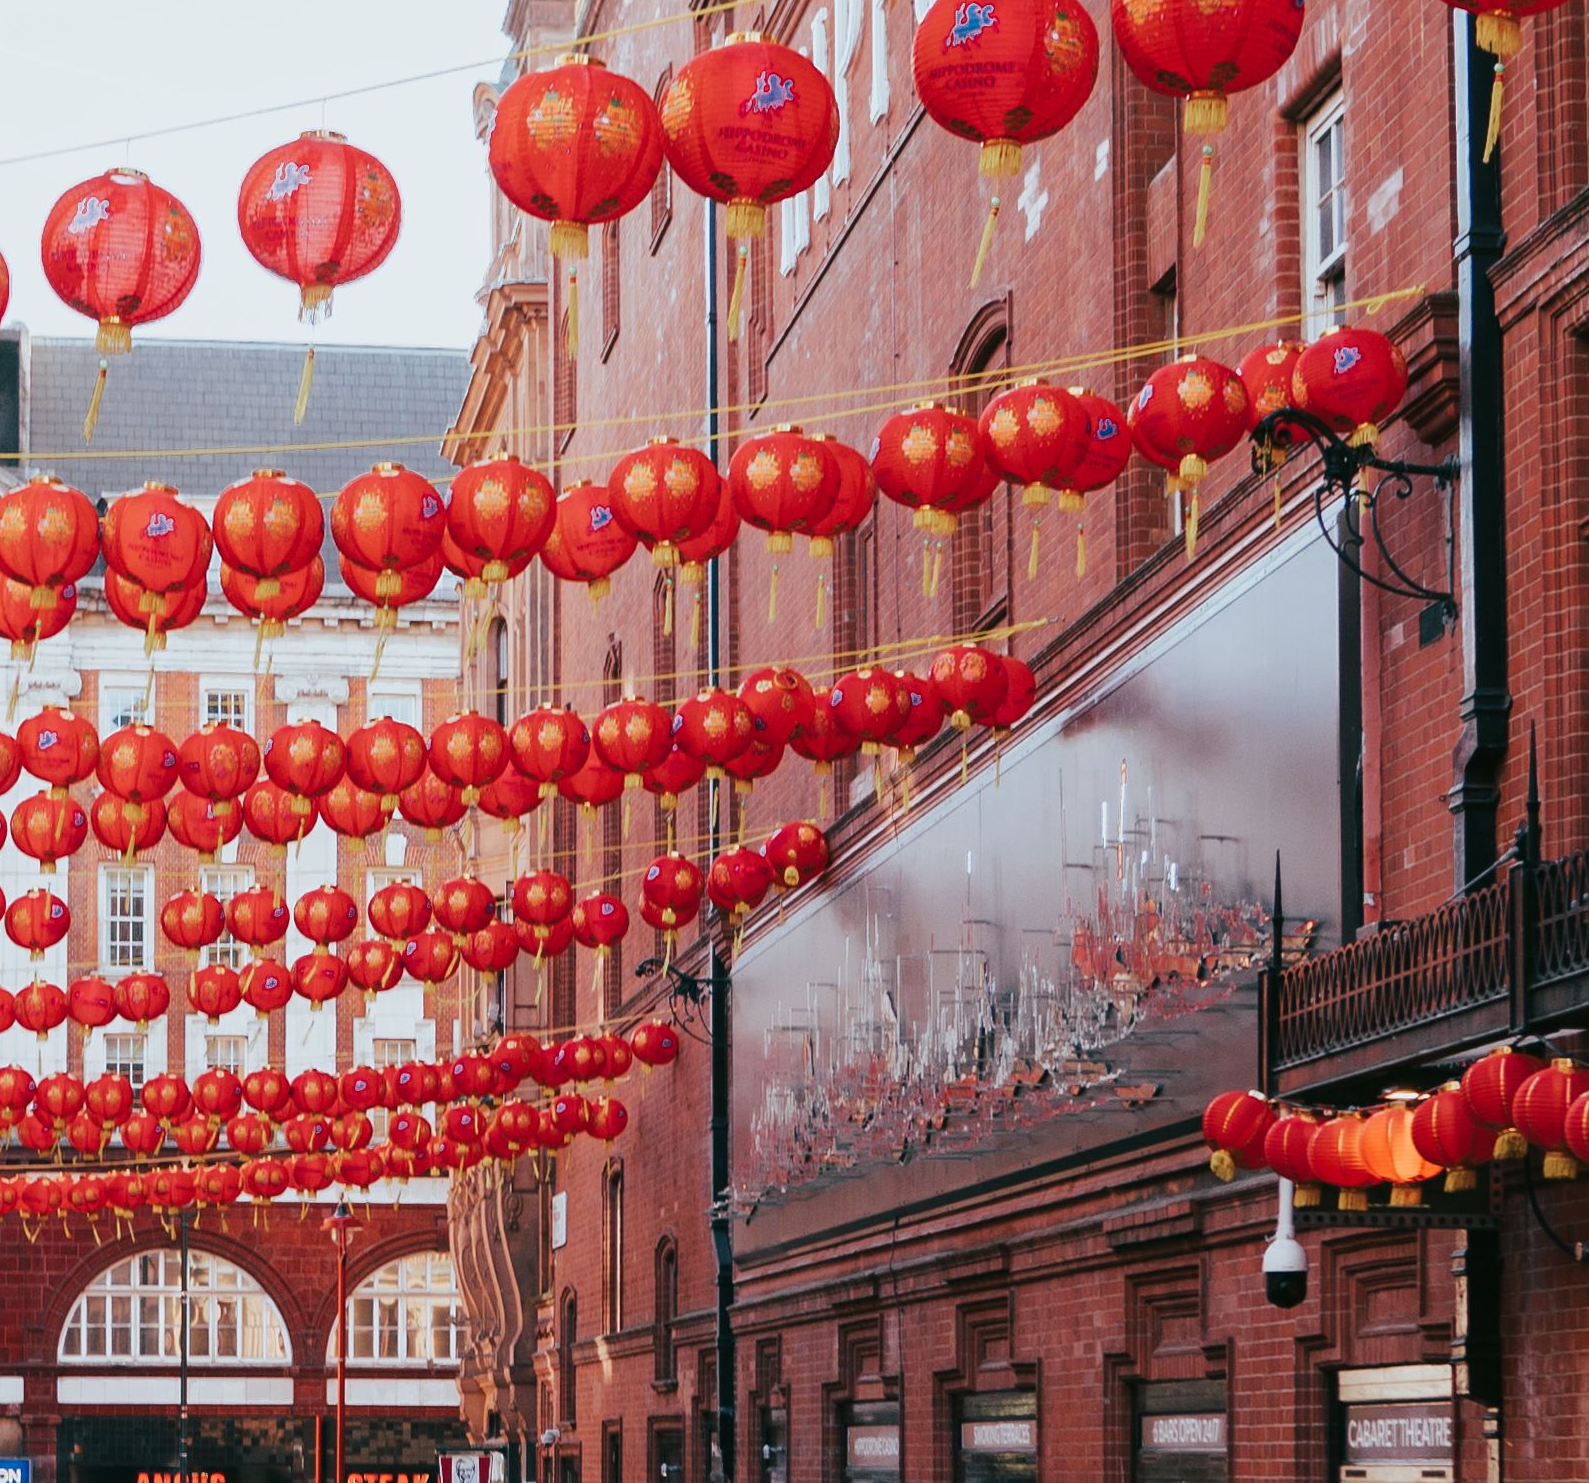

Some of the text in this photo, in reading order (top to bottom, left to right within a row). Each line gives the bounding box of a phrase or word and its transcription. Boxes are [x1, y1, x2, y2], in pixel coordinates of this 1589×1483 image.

[930, 60, 1015, 80] HIPPODROME
[945, 75, 995, 90] CASINO
[718, 127, 806, 149] HIPPODROME
[736, 143, 788, 159] CASINO
[1158, 1418, 1179, 1443] BARS
[1179, 1418, 1201, 1443] OPEN
[1348, 1417, 1452, 1448] CABARET THEATRE
